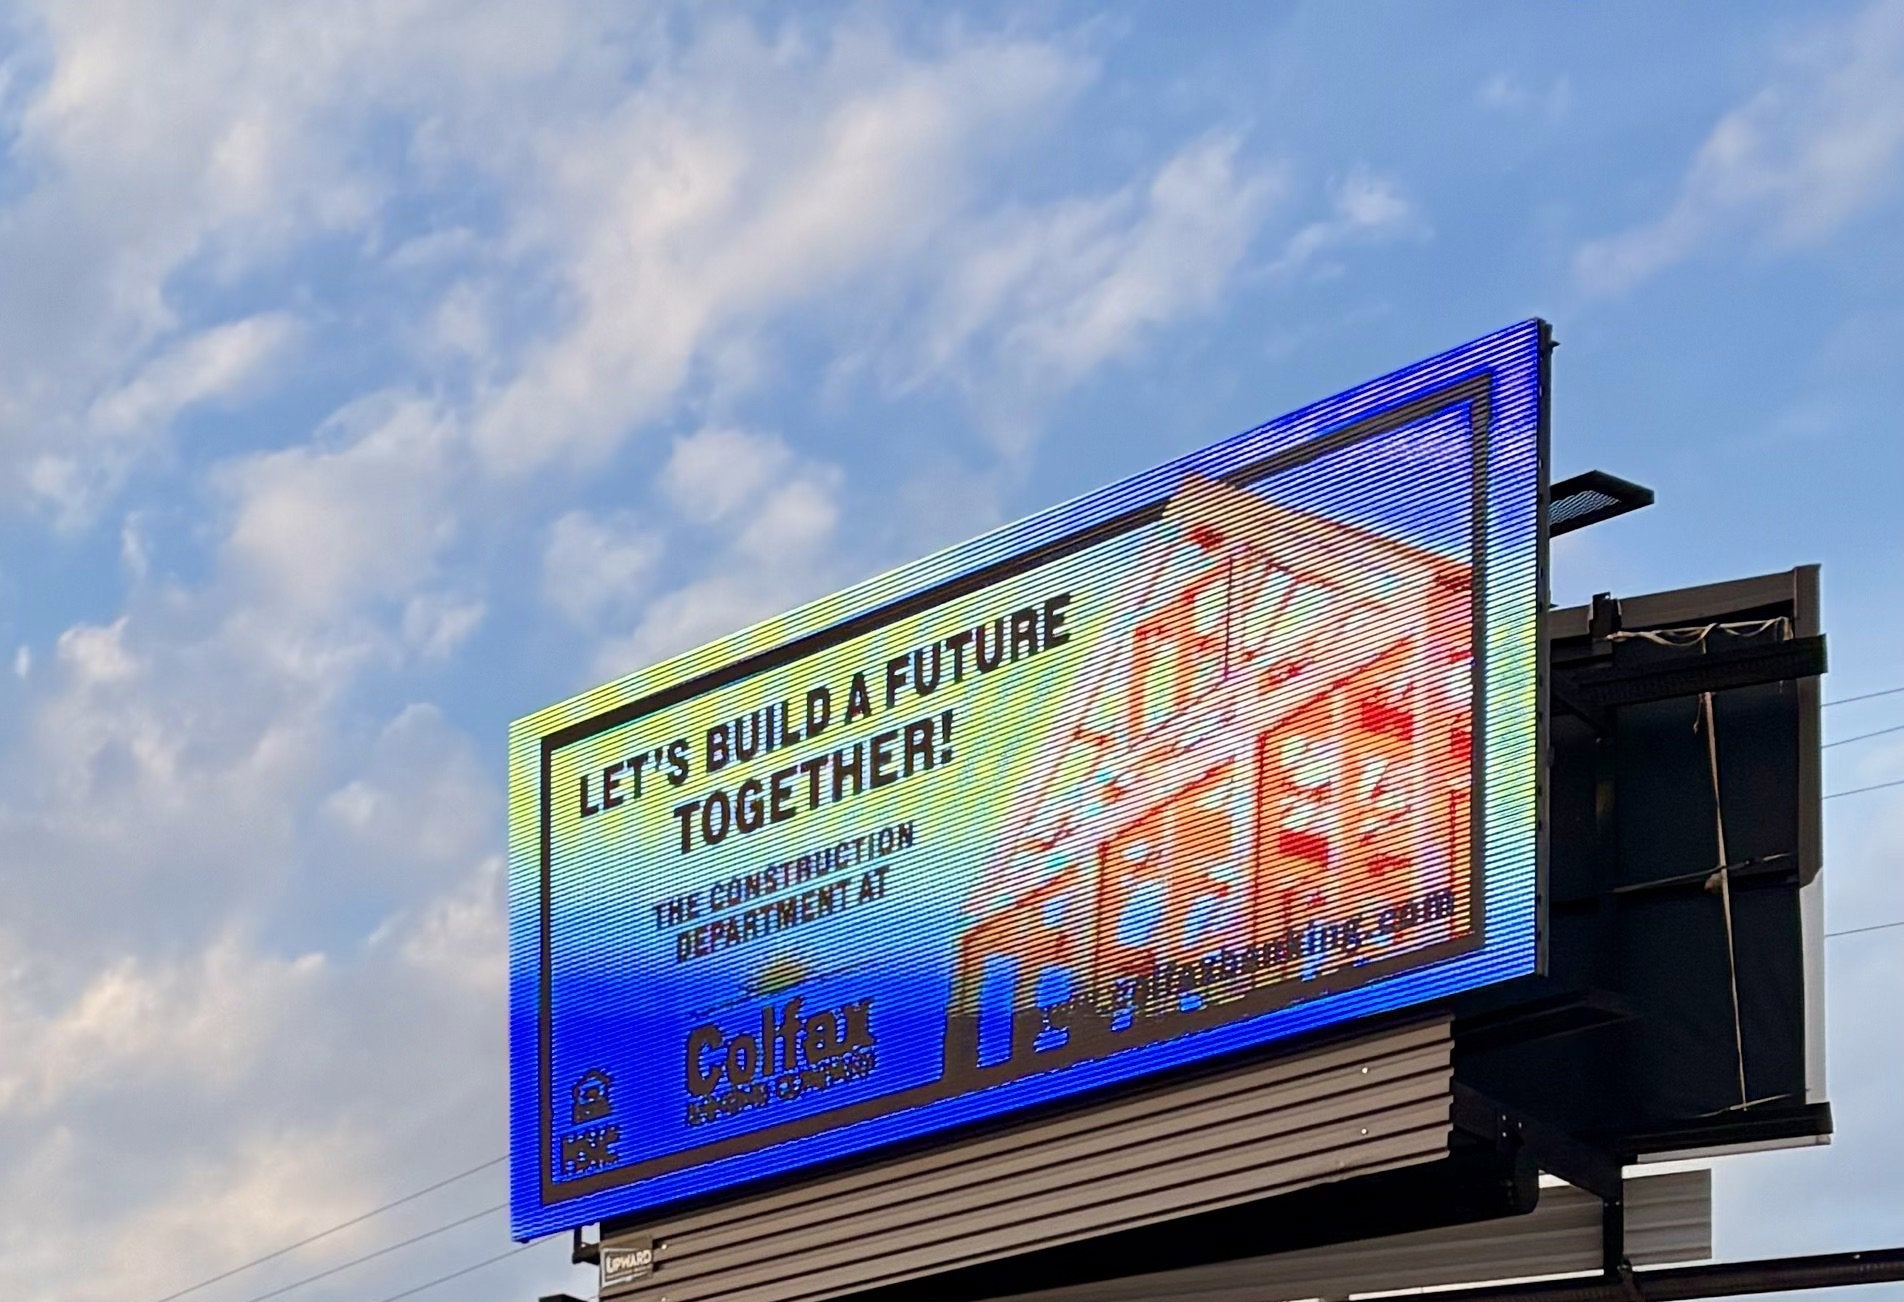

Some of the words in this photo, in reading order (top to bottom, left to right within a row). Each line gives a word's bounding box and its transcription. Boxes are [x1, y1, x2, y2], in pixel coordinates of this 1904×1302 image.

[579, 738, 689, 818] LET'S
[706, 686, 831, 774] BUILD
[844, 672, 873, 725] A
[886, 593, 1072, 710] FUTURE
[674, 708, 955, 855] TOGETHER!
[652, 890, 703, 930] THE
[710, 819, 914, 913] CONSTRUCTION
[676, 879, 851, 964] DEPARTMENT
[858, 865, 890, 905] AT
[685, 996, 876, 1096] Colfax
[606, 1249, 652, 1274] UPWARD
